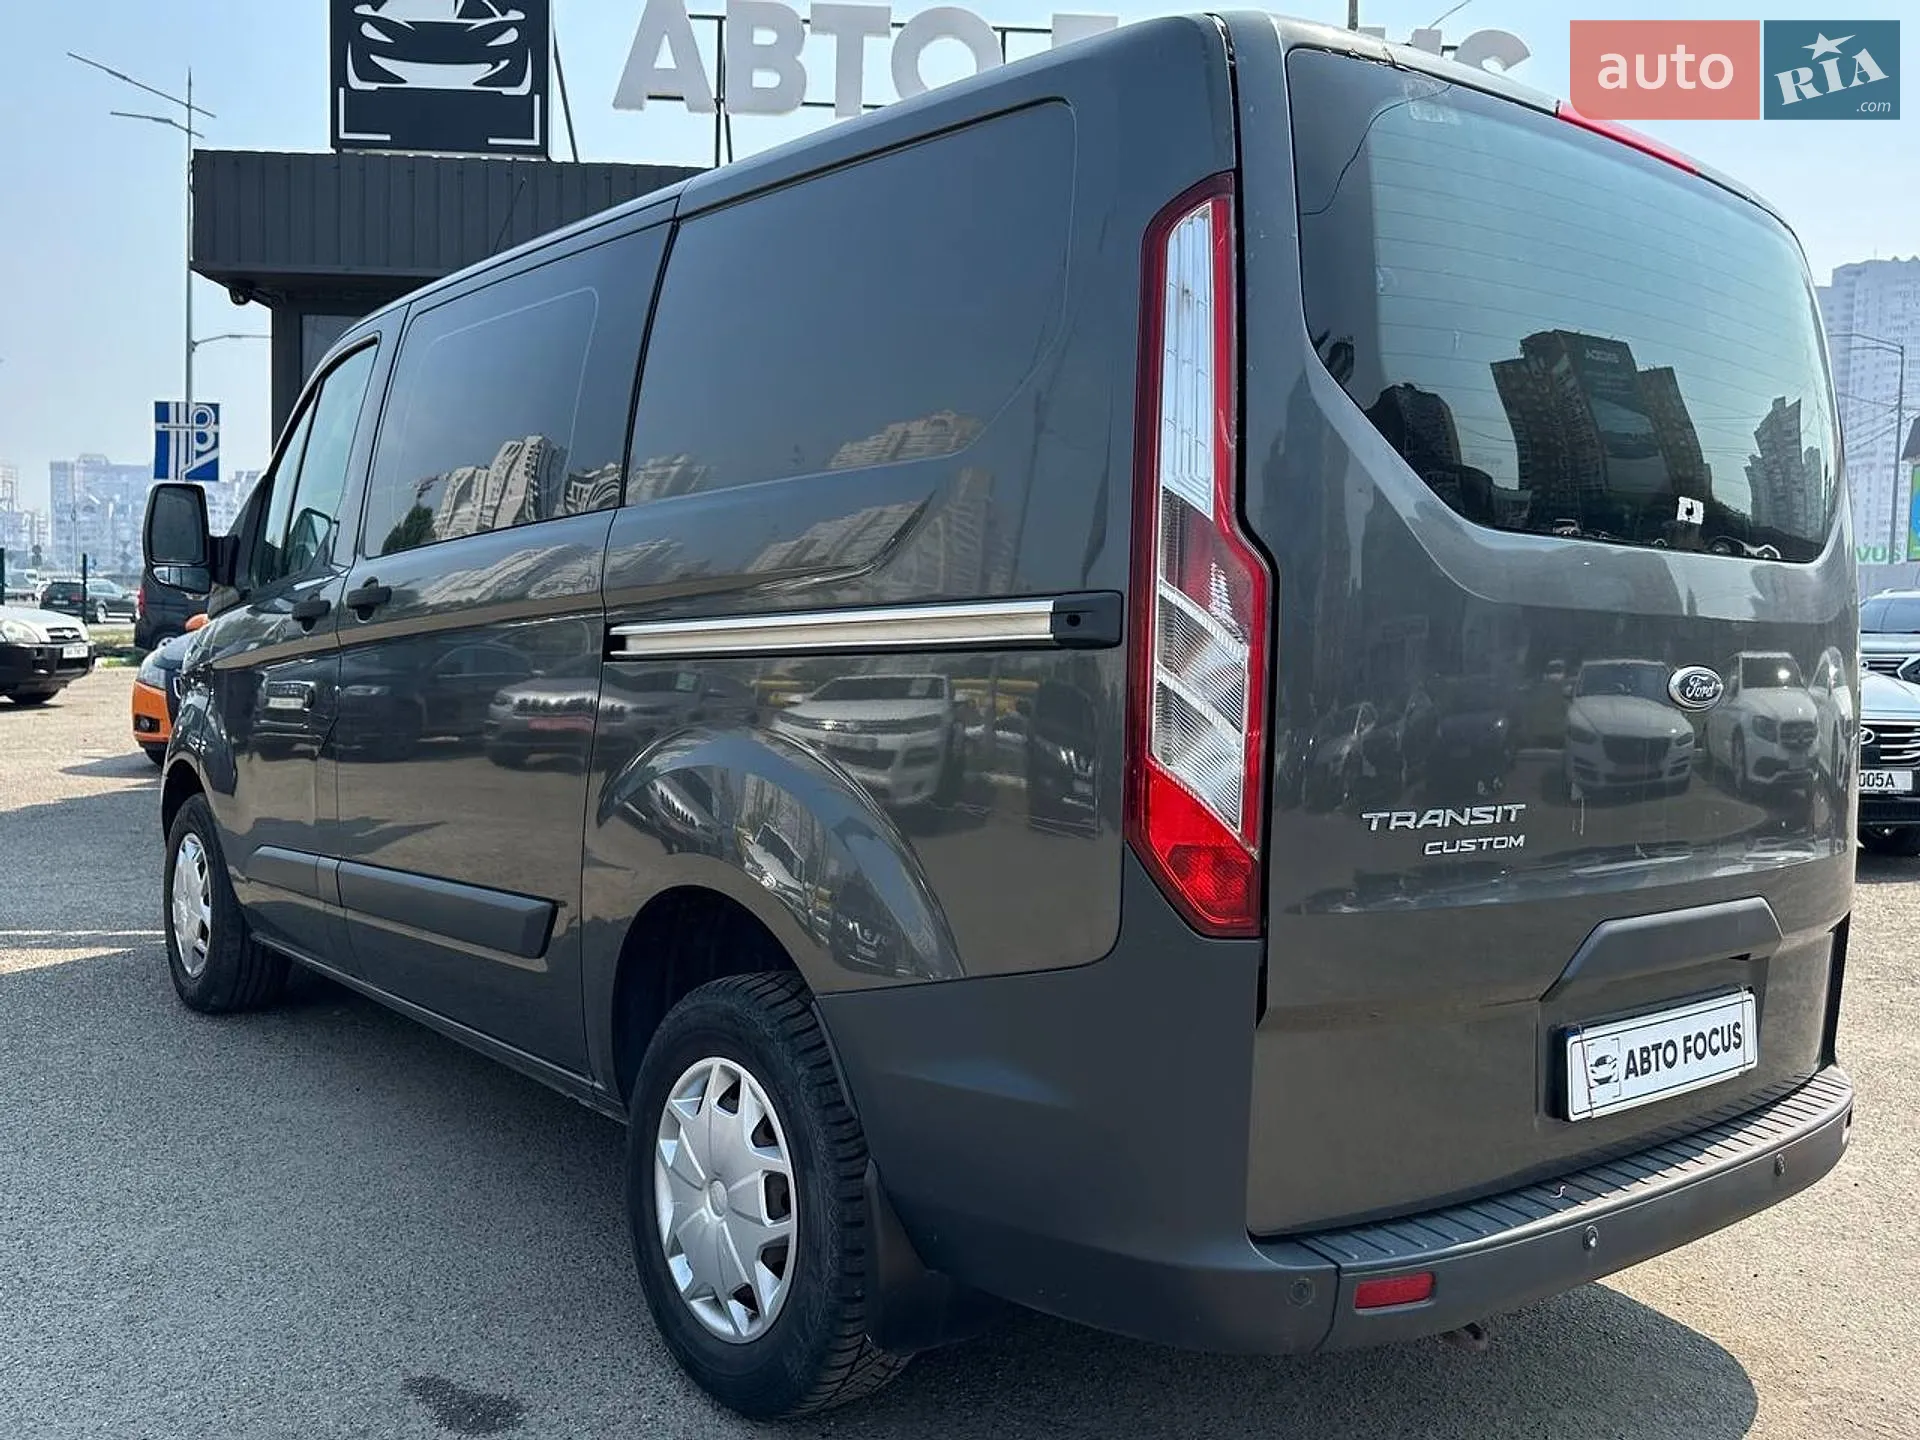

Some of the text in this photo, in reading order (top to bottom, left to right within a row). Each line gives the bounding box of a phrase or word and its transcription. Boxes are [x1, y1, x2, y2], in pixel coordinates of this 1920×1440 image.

[613, 0, 1001, 118] АВТО
[1686, 675, 1716, 698] Ford
[1361, 803, 1527, 832] TRANSIT
[1424, 834, 1526, 856] CUSTOM
[1623, 1021, 1742, 1081] АВТО FOCUS
